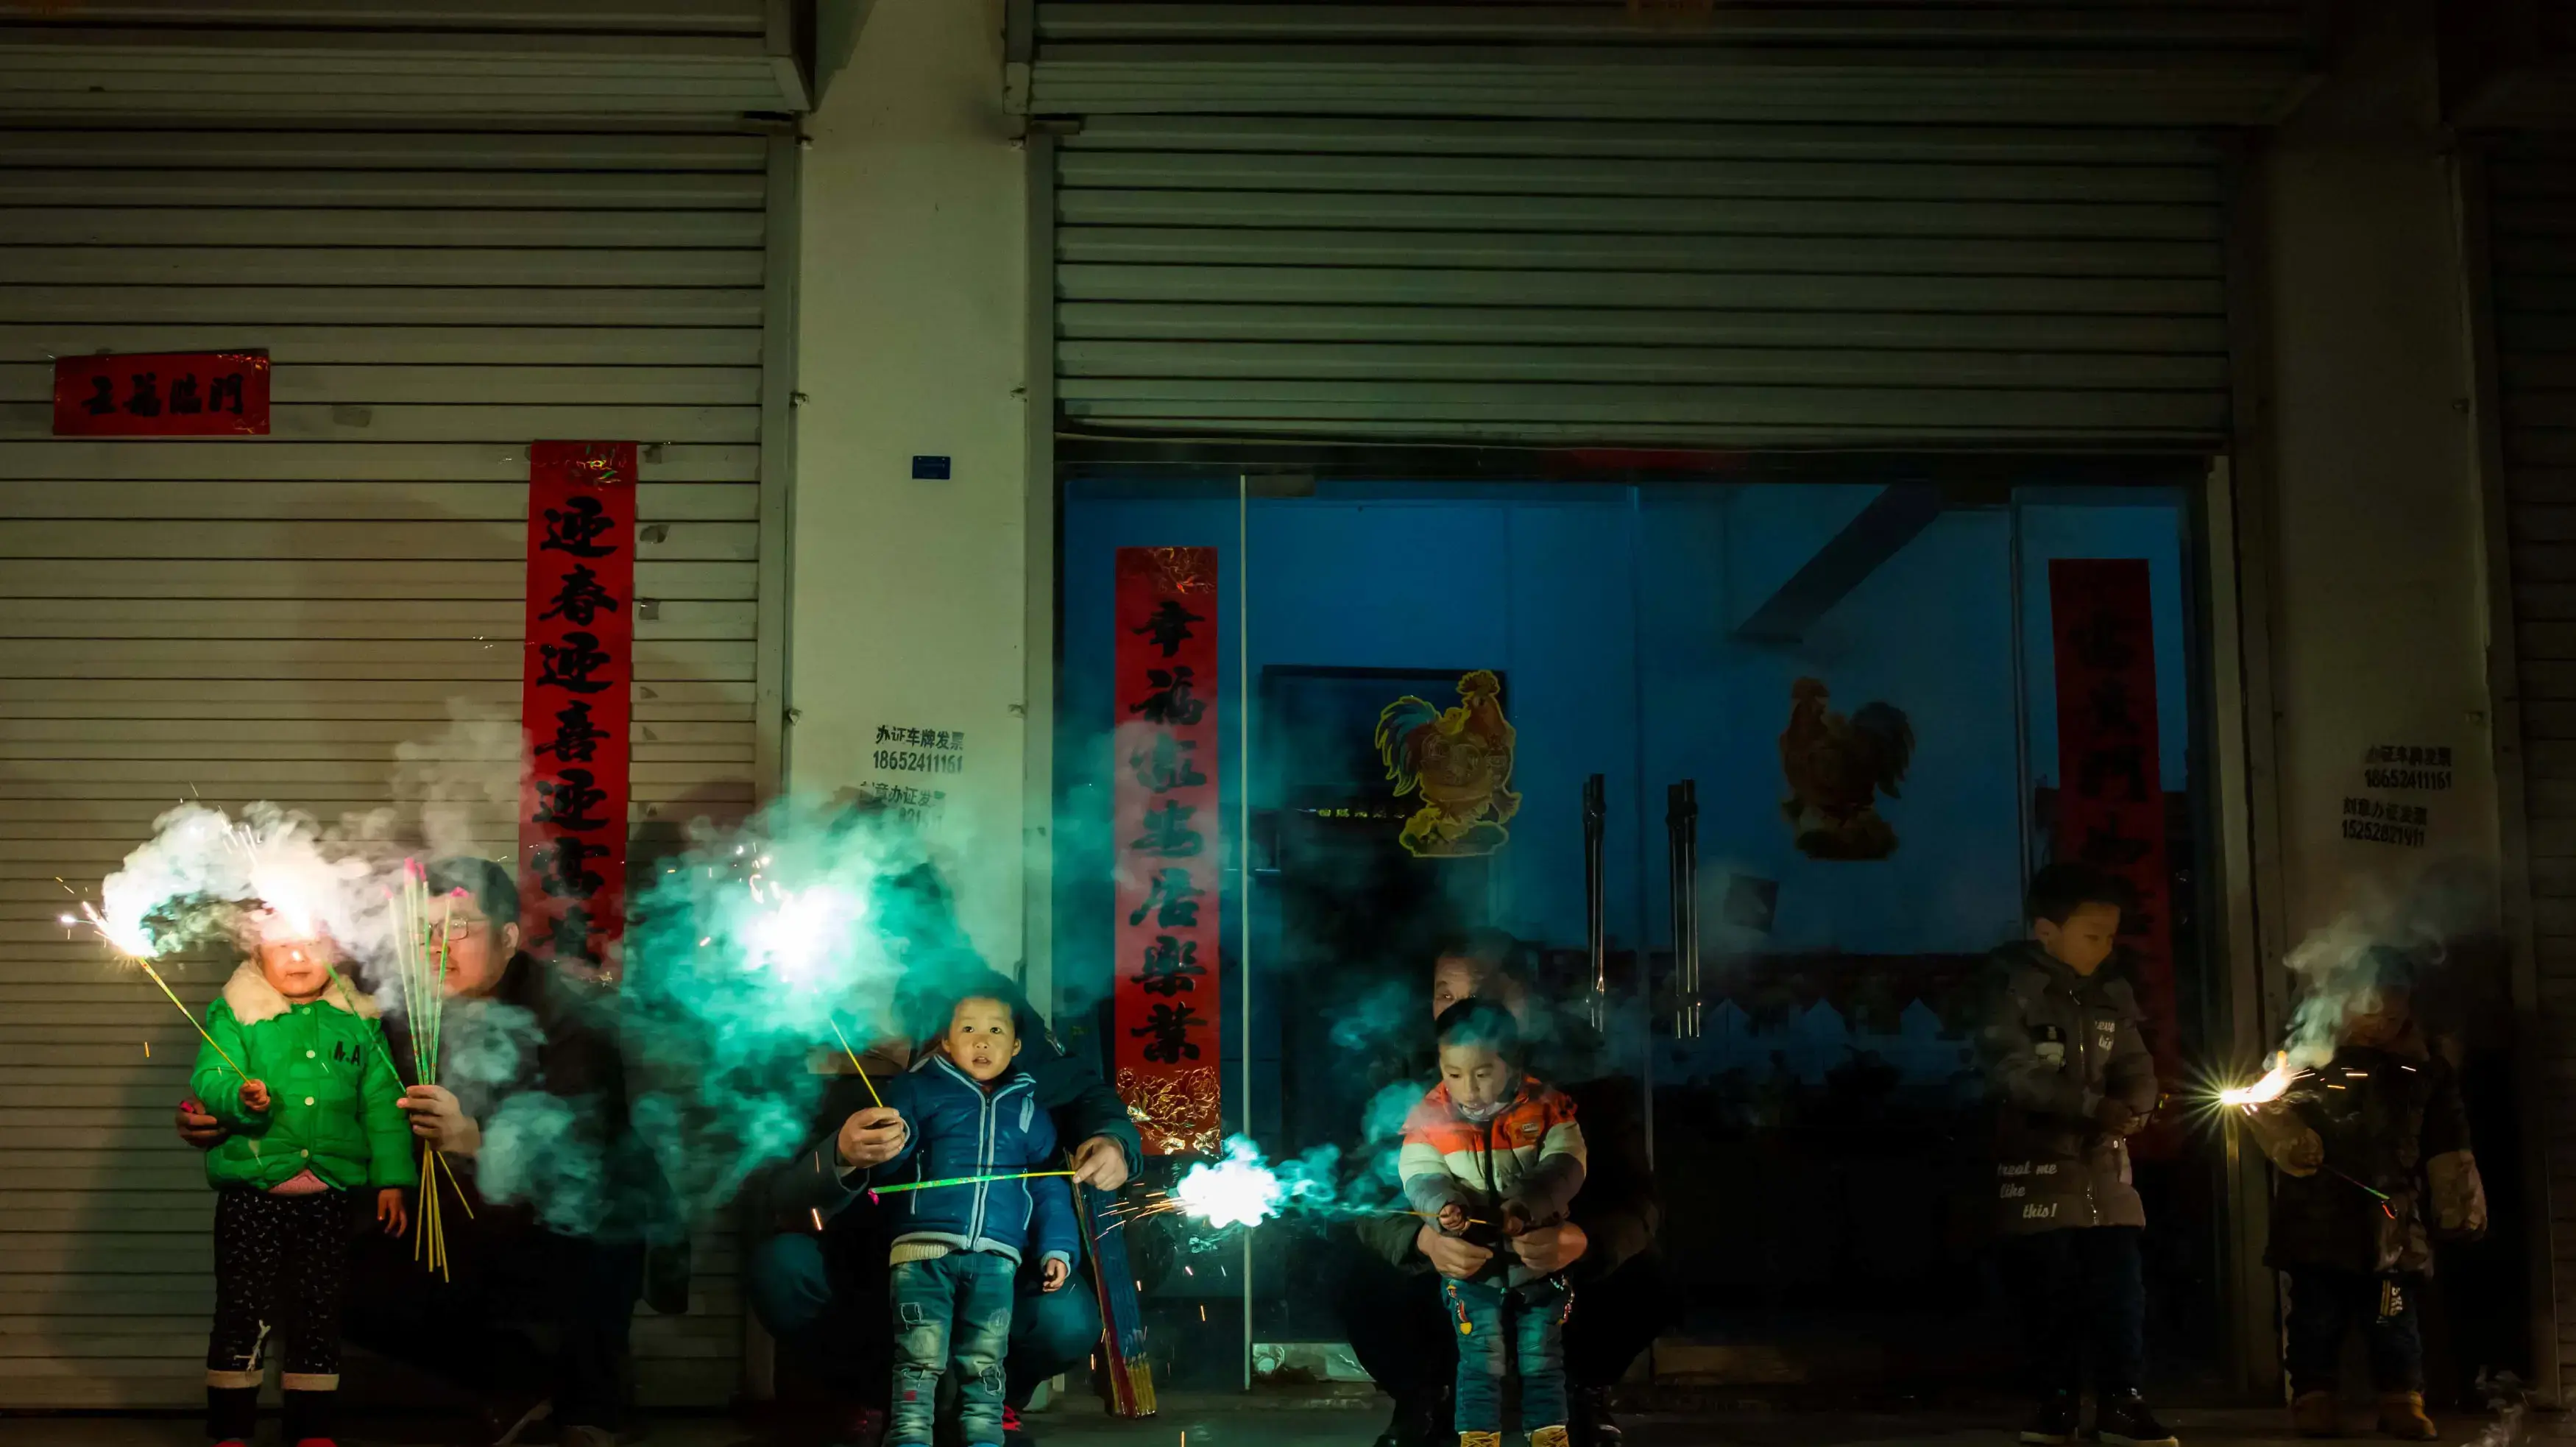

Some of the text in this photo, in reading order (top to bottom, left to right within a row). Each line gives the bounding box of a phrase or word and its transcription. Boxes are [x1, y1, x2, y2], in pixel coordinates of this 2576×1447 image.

[875, 724, 965, 751] 办证车牌发票
[874, 750, 963, 774] 18652411161
[2364, 768, 2452, 790] 18652411161
[2036, 1164, 2058, 1175] me
[2000, 1183, 2026, 1199] like
[2022, 1202, 2059, 1219] this!
